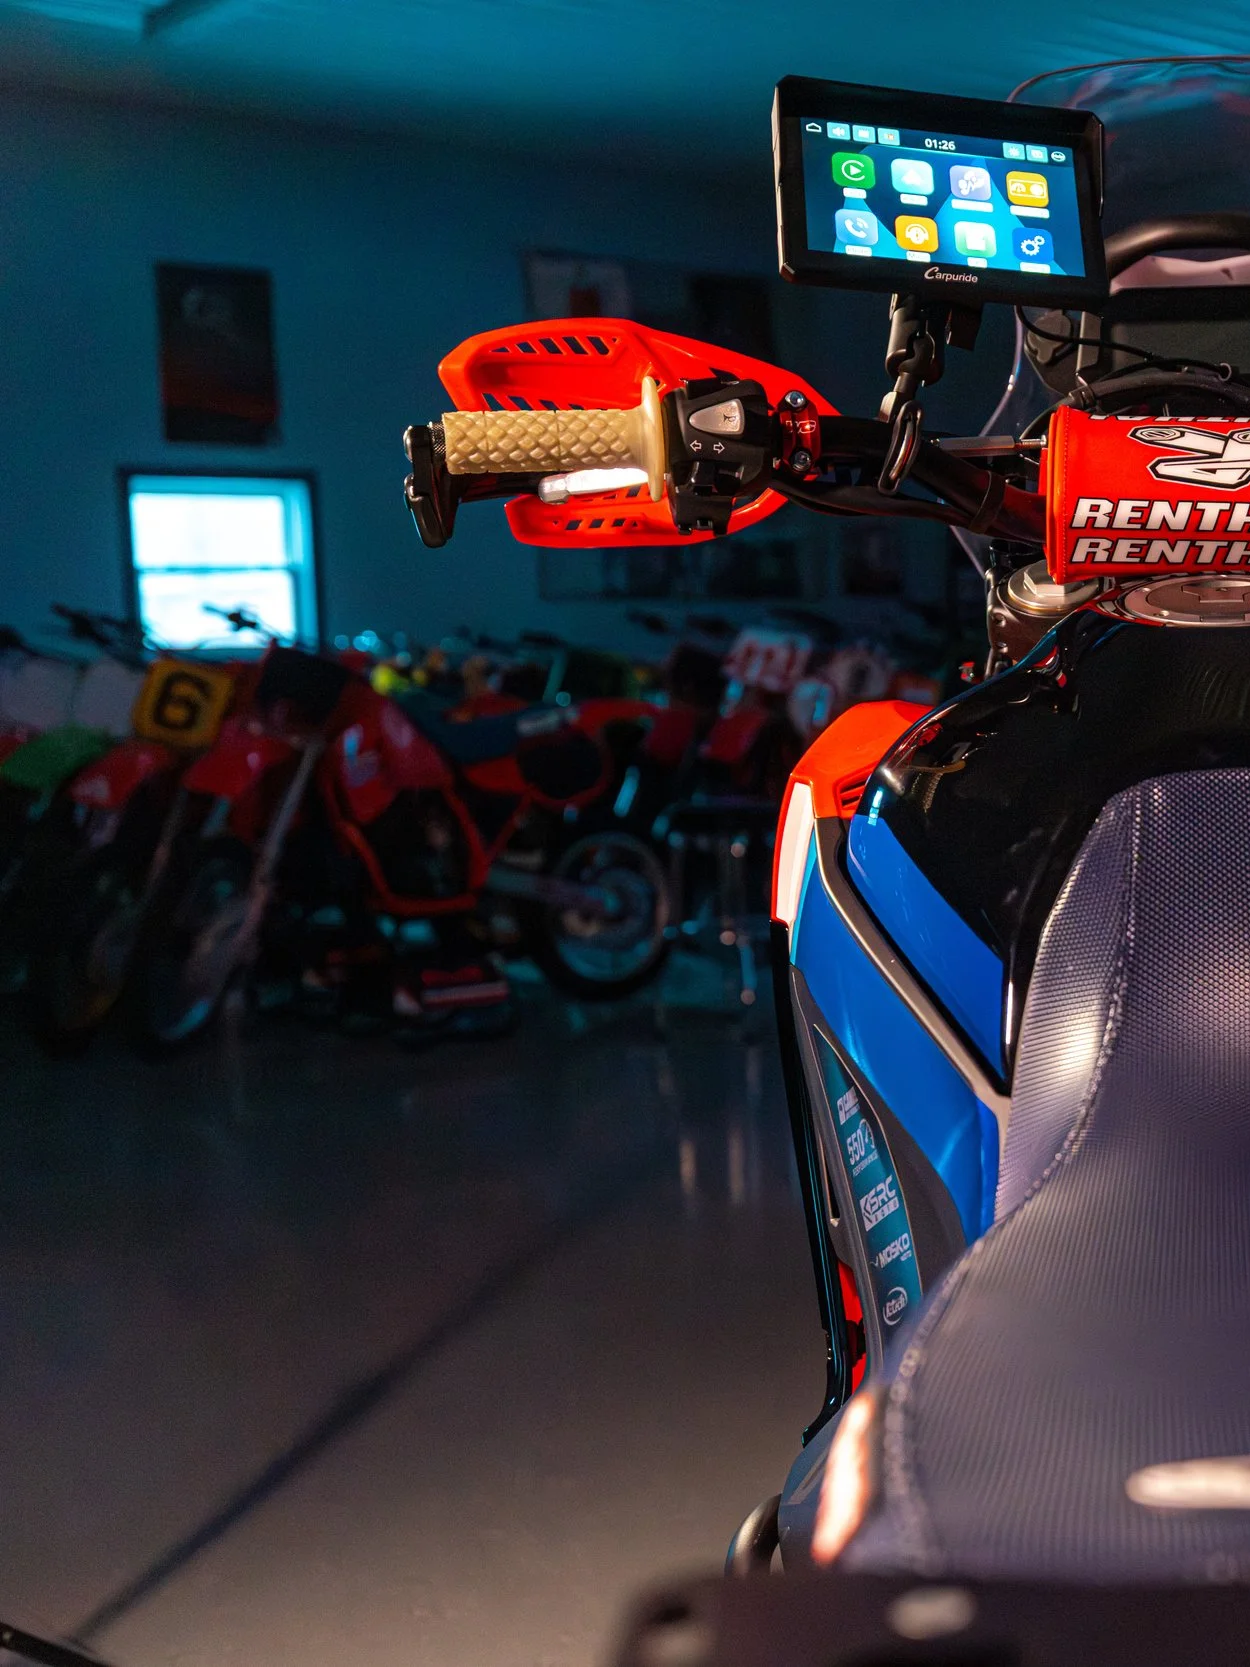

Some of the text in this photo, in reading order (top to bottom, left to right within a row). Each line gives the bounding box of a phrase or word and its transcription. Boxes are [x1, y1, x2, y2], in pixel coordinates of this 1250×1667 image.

[924, 137, 956, 151] 01:26
[924, 266, 979, 283] Carpuride
[153, 671, 211, 730] 6
[846, 1127, 866, 1166] 550
[878, 1232, 910, 1269] MOSKO
